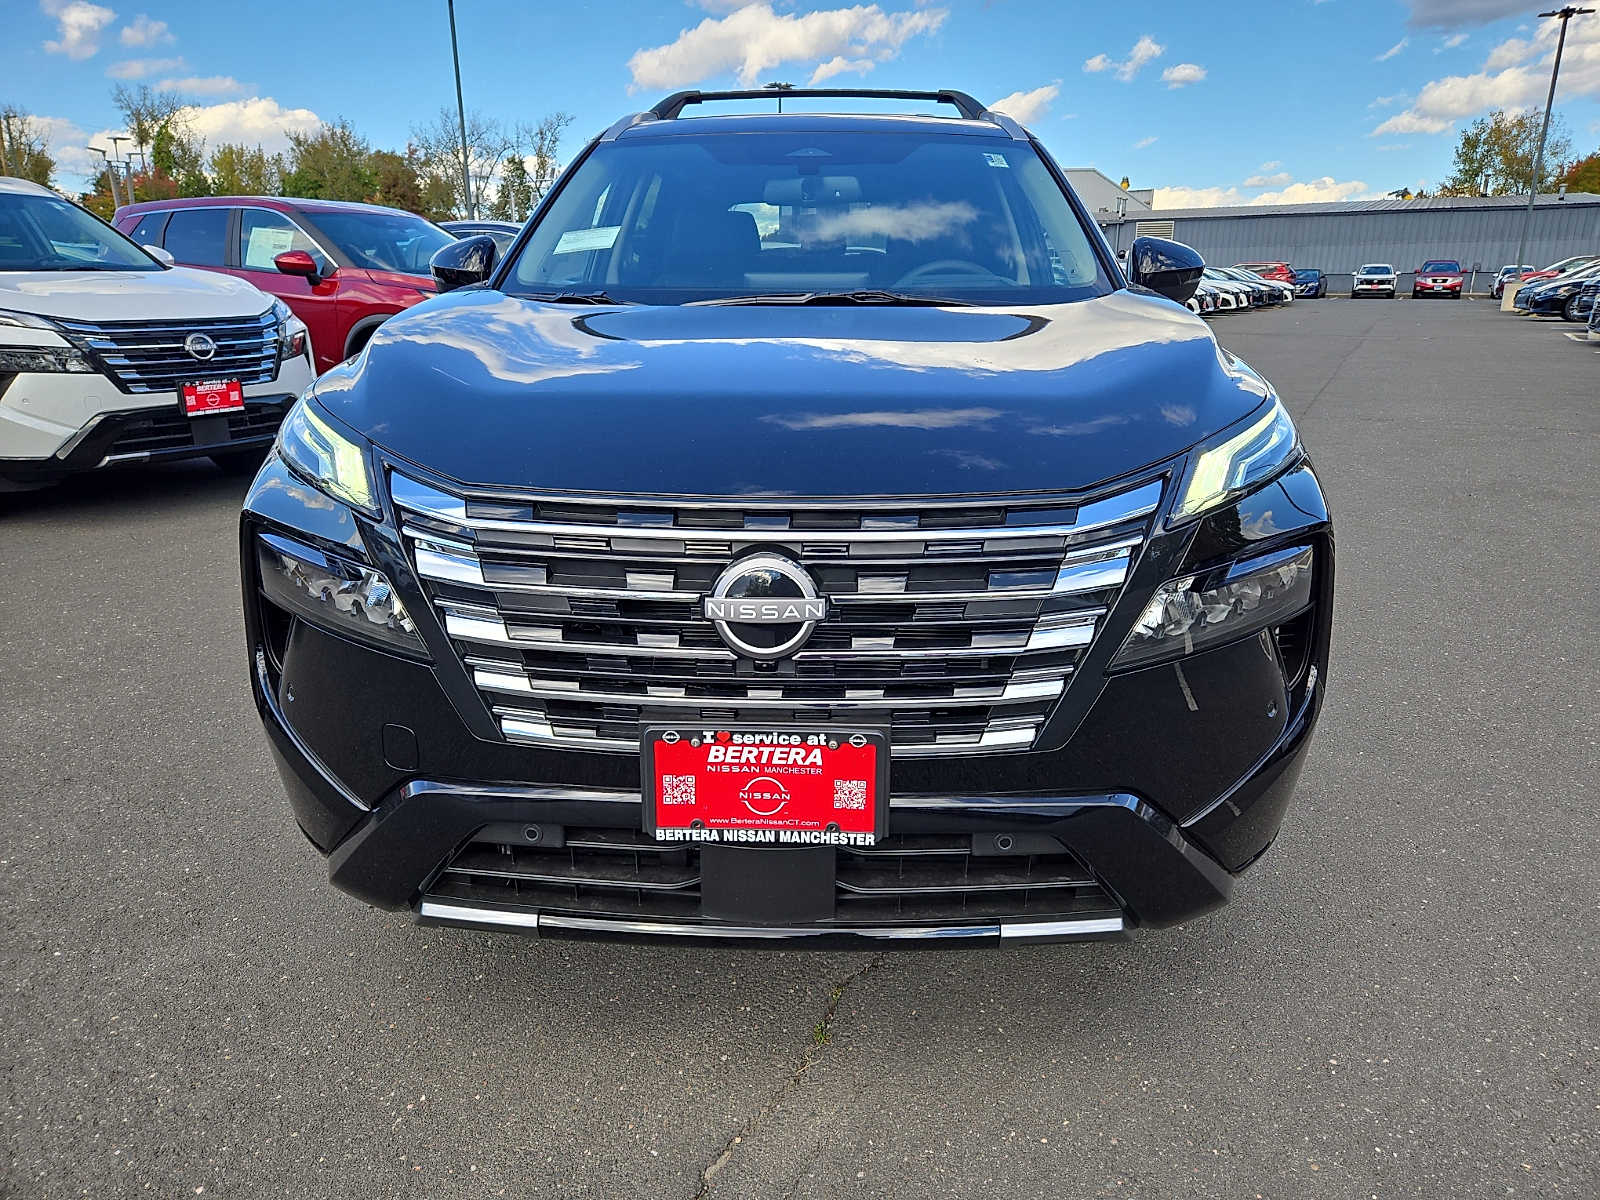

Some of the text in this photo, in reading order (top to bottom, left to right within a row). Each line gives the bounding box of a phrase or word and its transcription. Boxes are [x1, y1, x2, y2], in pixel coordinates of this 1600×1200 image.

[707, 602, 823, 619] NISSAN
[702, 731, 827, 746] I service at
[707, 746, 823, 766] BERTERA
[706, 765, 823, 775] NISSAN MANCHESTER
[739, 791, 791, 800] NISSAN
[655, 828, 876, 846] BERTERA NISSAN MANCHESTER
